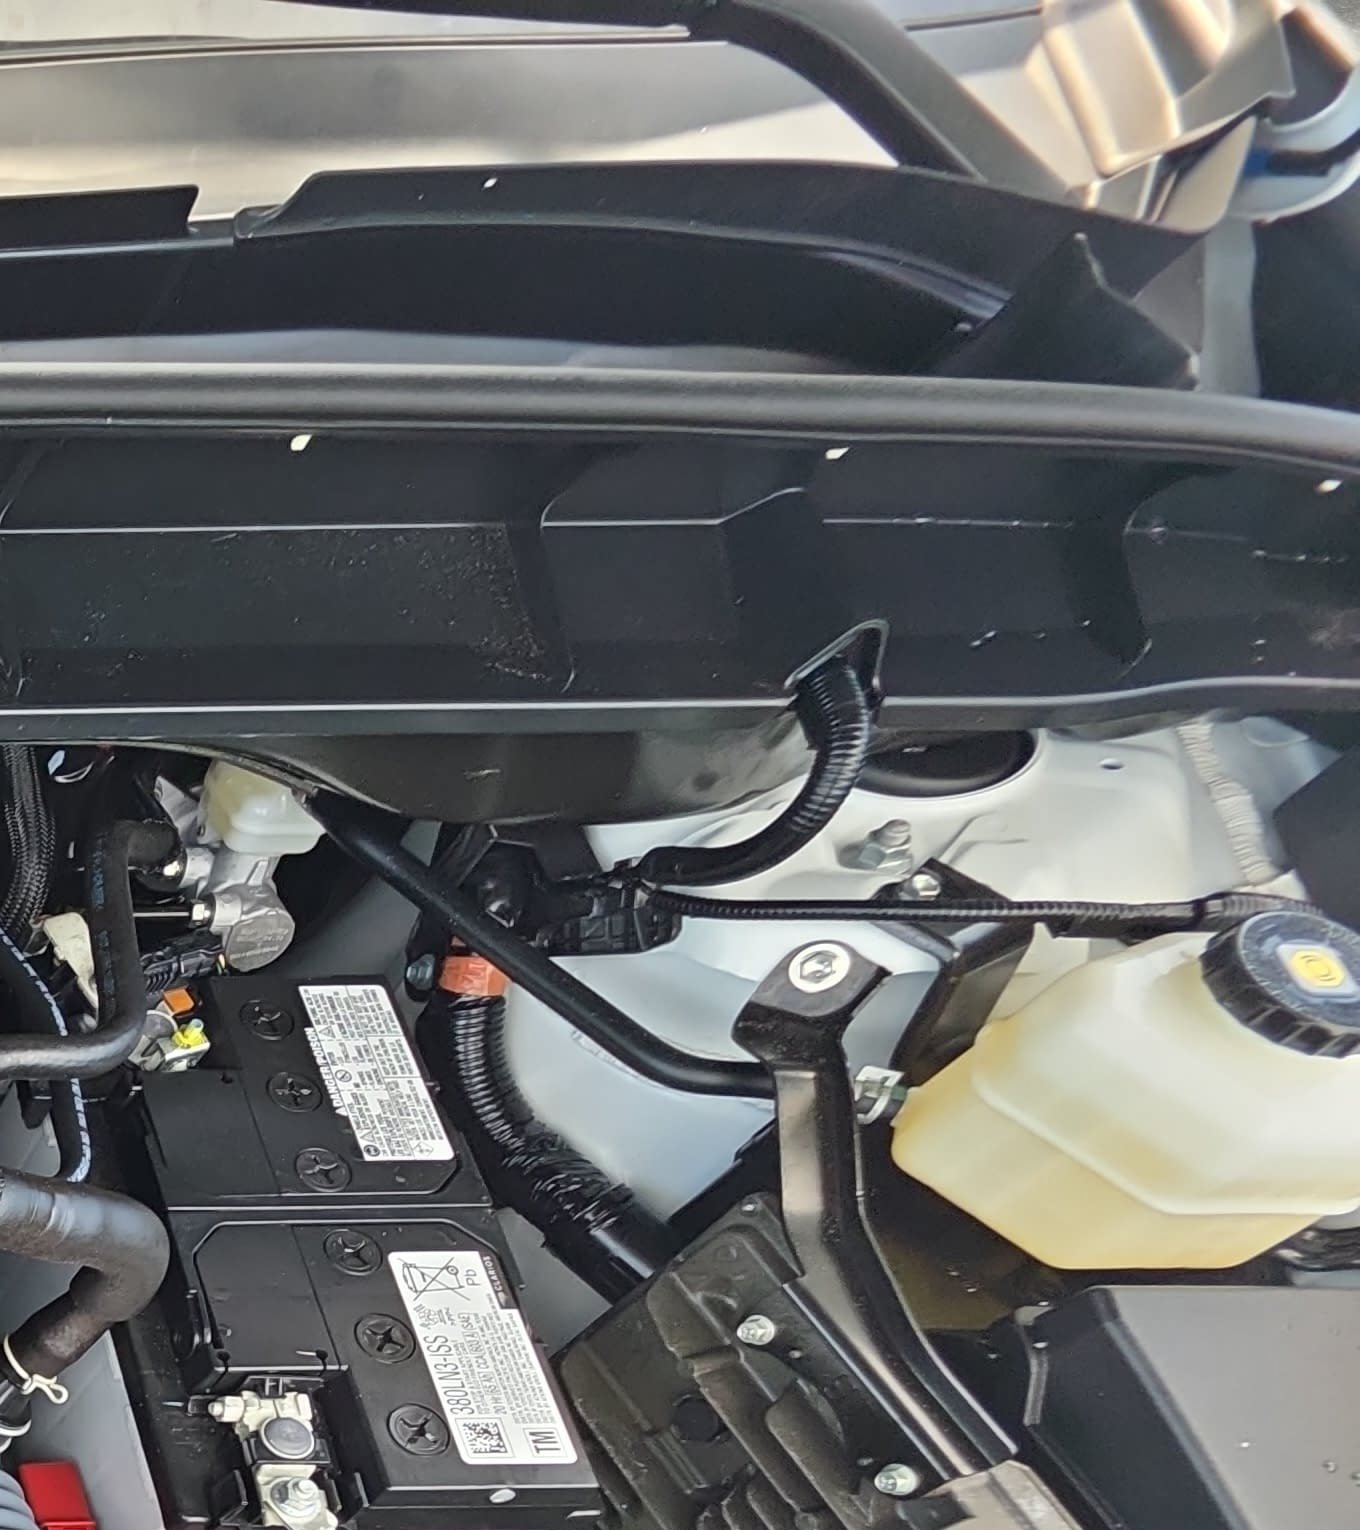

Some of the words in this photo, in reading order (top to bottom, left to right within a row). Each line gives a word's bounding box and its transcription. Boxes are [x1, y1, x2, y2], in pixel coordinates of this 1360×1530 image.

[464, 1269, 481, 1287] Pb
[421, 1334, 477, 1415] 380LN3-ISS
[527, 1430, 563, 1453] TM
